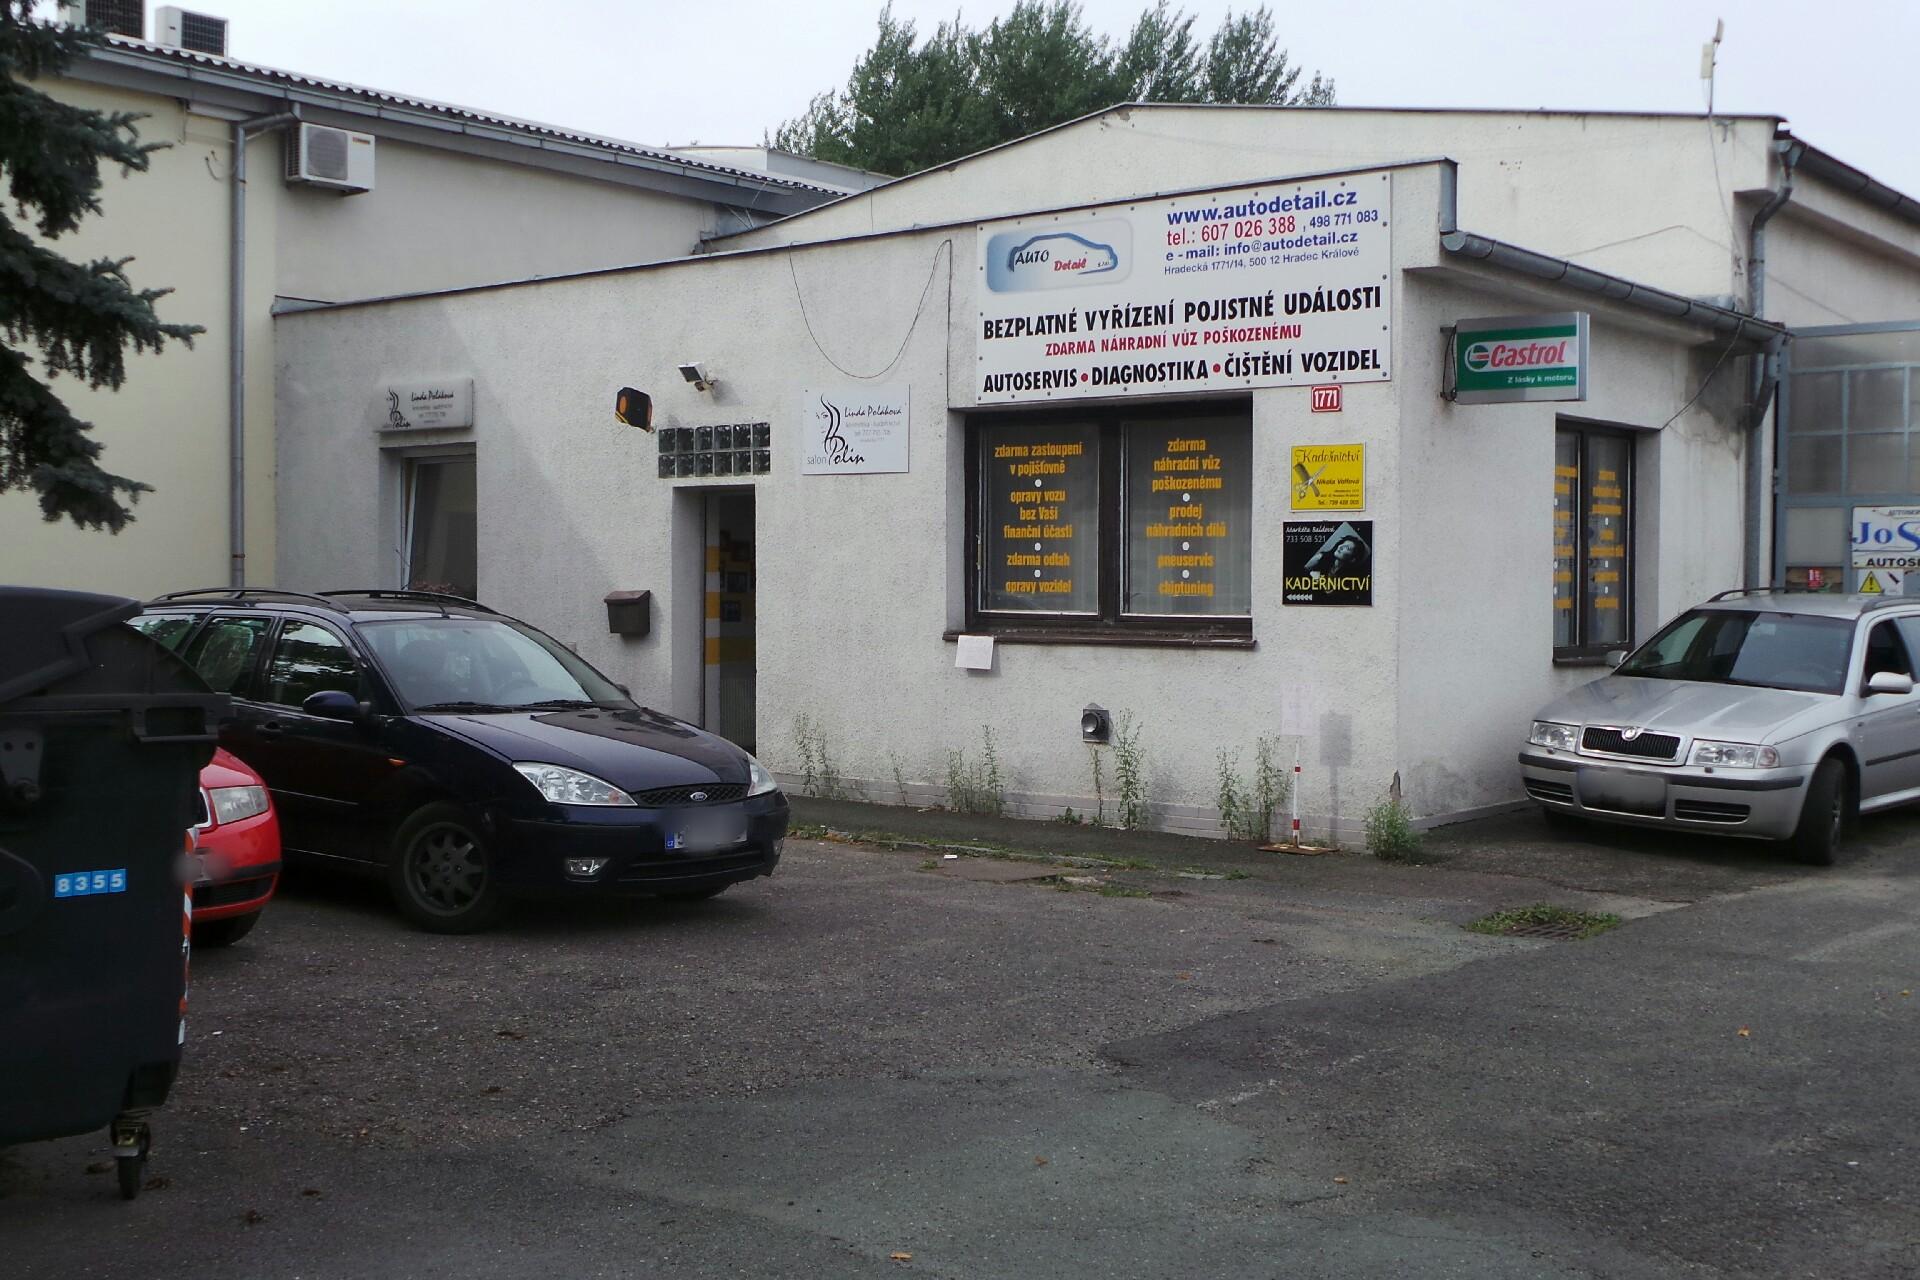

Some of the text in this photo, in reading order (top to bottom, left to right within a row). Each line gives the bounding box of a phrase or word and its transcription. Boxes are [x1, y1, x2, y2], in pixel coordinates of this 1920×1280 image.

[1167, 191, 1357, 225] www.autodetail.cz
[1167, 227, 1196, 246] tel.:
[1201, 223, 1228, 242] 607
[1234, 219, 1263, 239] 026
[1268, 215, 1296, 235] 388
[1309, 215, 1330, 229] 498
[1334, 212, 1351, 226] 771
[1356, 210, 1378, 223] 083
[1224, 231, 1358, 256] info@autodetail.cz
[1015, 249, 1050, 265] AUTO
[1054, 258, 1087, 271] Detail
[1164, 260, 1208, 276] Hradecká
[1249, 256, 1267, 268] 500
[1270, 255, 1280, 265] 12
[1283, 251, 1318, 264] Hradec
[1322, 247, 1359, 260] Králové
[983, 285, 1381, 340] BEZPLATNÉ VYŘÍZENÍ POJISTNÉ UDÁLOSTI
[1045, 340, 1096, 356] ZDARMA
[1101, 330, 1167, 352] NÁHRADNÍ
[1203, 321, 1302, 344] POŠKOZENÉMU
[1490, 341, 1568, 368] Castrol
[983, 348, 1381, 394] AUTOSERVIS DIAGNOSTIKA ČIŠTĚNÍ VOZIDEL
[1314, 389, 1338, 408] 1771
[844, 405, 866, 418] Linda
[994, 442, 1083, 458] zdarma zastoupení
[1167, 438, 1206, 451] zdarma
[1010, 465, 1016, 474] v
[1152, 475, 1222, 492] poškozenému
[1010, 490, 1066, 504] opravy vozu
[1019, 506, 1036, 520] bez
[1169, 504, 1202, 520] prodej
[1006, 552, 1070, 566] zdarma odtah
[1157, 552, 1214, 569] pneuservis
[1005, 580, 1036, 594] opravy
[1159, 581, 1214, 597] chiptuning
[1285, 575, 1371, 591] KADEŘNICTVÍ
[57, 874, 123, 893] 8355
